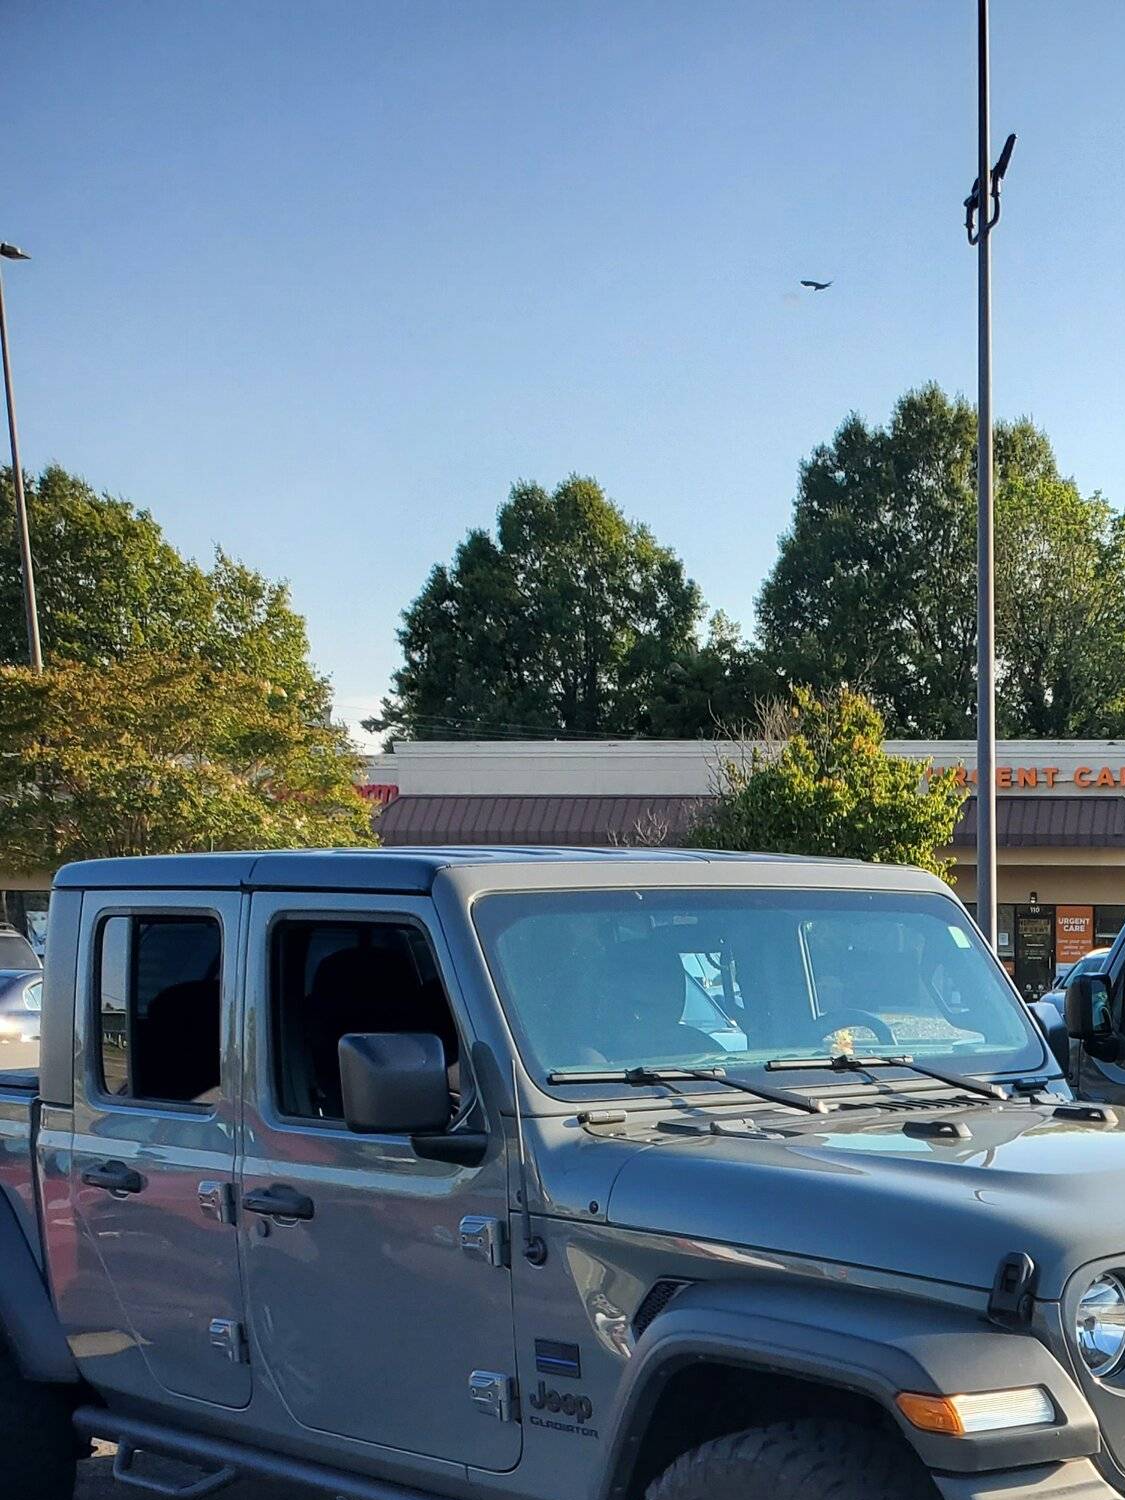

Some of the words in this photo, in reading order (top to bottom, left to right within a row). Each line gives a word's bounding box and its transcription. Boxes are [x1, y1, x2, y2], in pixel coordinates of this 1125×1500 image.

[1030, 906, 1040, 914] 110
[1058, 917, 1090, 925] URGENT
[1063, 924, 1086, 932] CARE
[529, 1380, 593, 1425] Jeep
[530, 1415, 599, 1440] GLADIATOR
